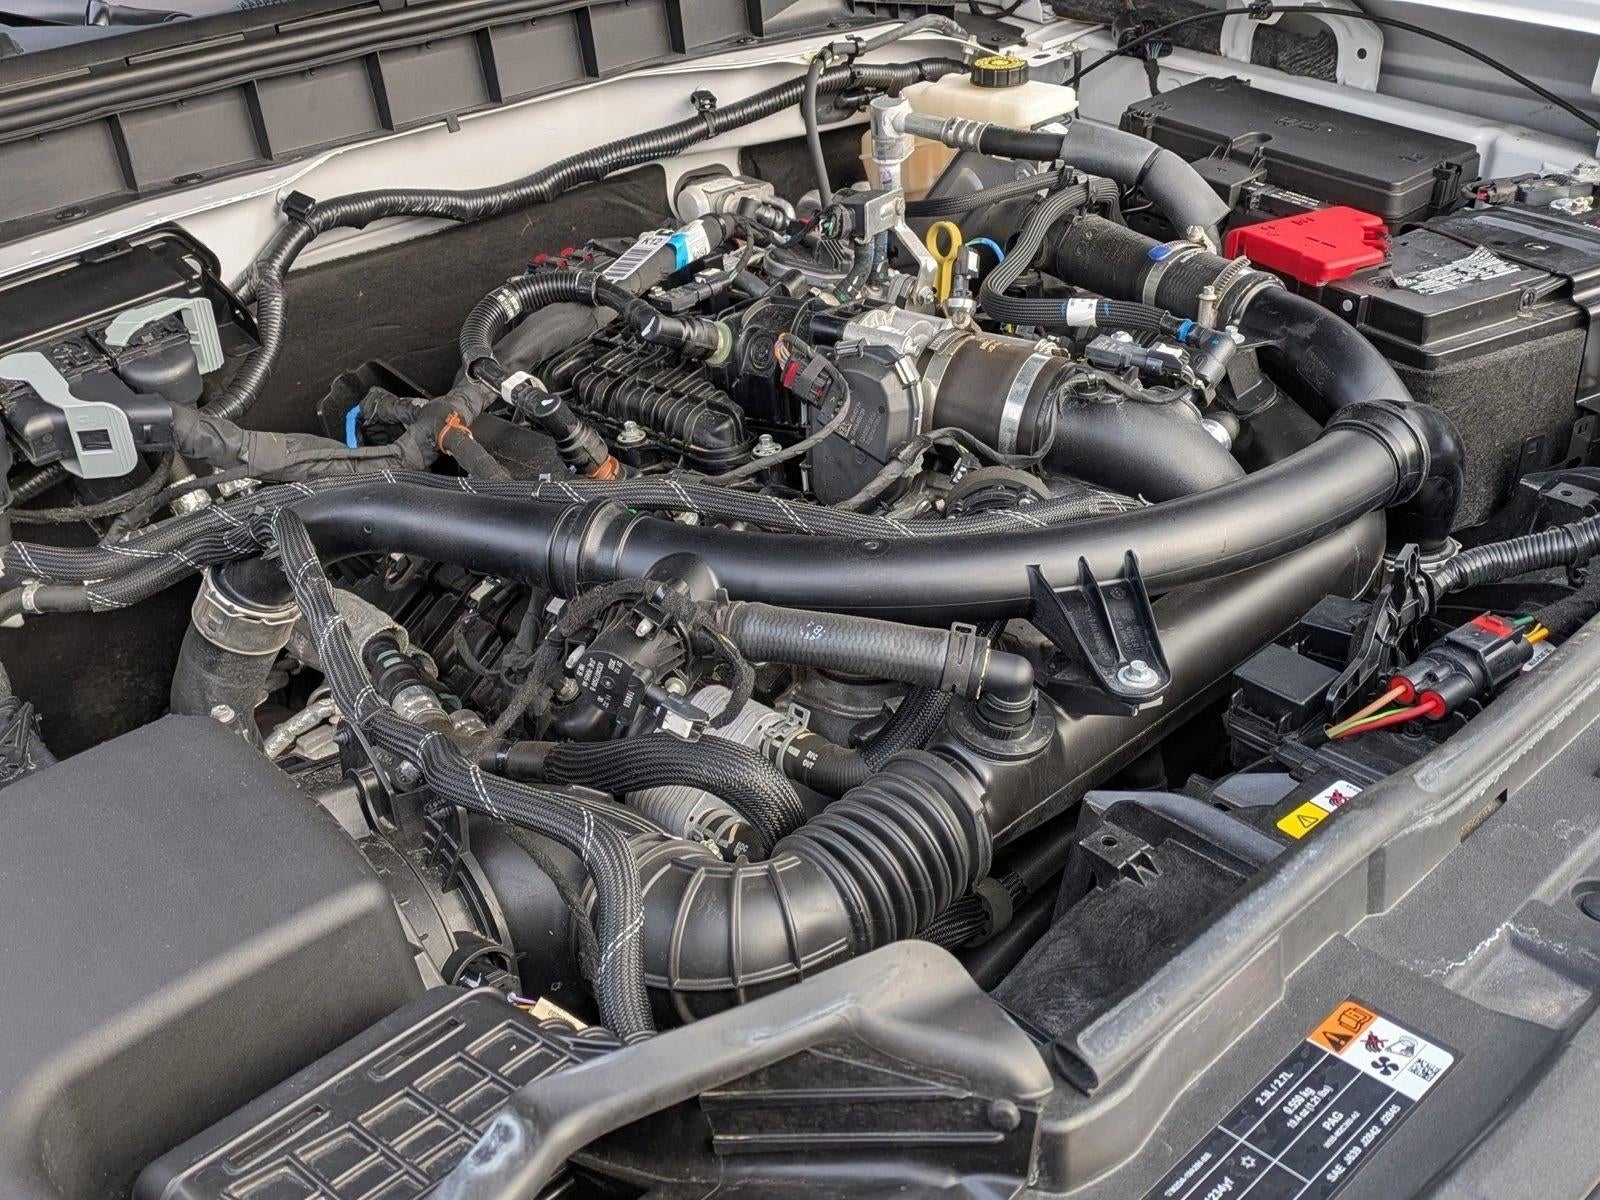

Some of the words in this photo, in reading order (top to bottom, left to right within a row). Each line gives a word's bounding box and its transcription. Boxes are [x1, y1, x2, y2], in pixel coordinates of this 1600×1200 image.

[802, 759, 814, 769] OUT
[1254, 1086, 1275, 1106] 2.3L
[1273, 1067, 1293, 1088] 2.7L
[1299, 1084, 1315, 1100] kg
[1321, 1109, 1344, 1131] PAG
[1325, 1162, 1346, 1183] SAE
[1342, 1144, 1362, 1165] J639
